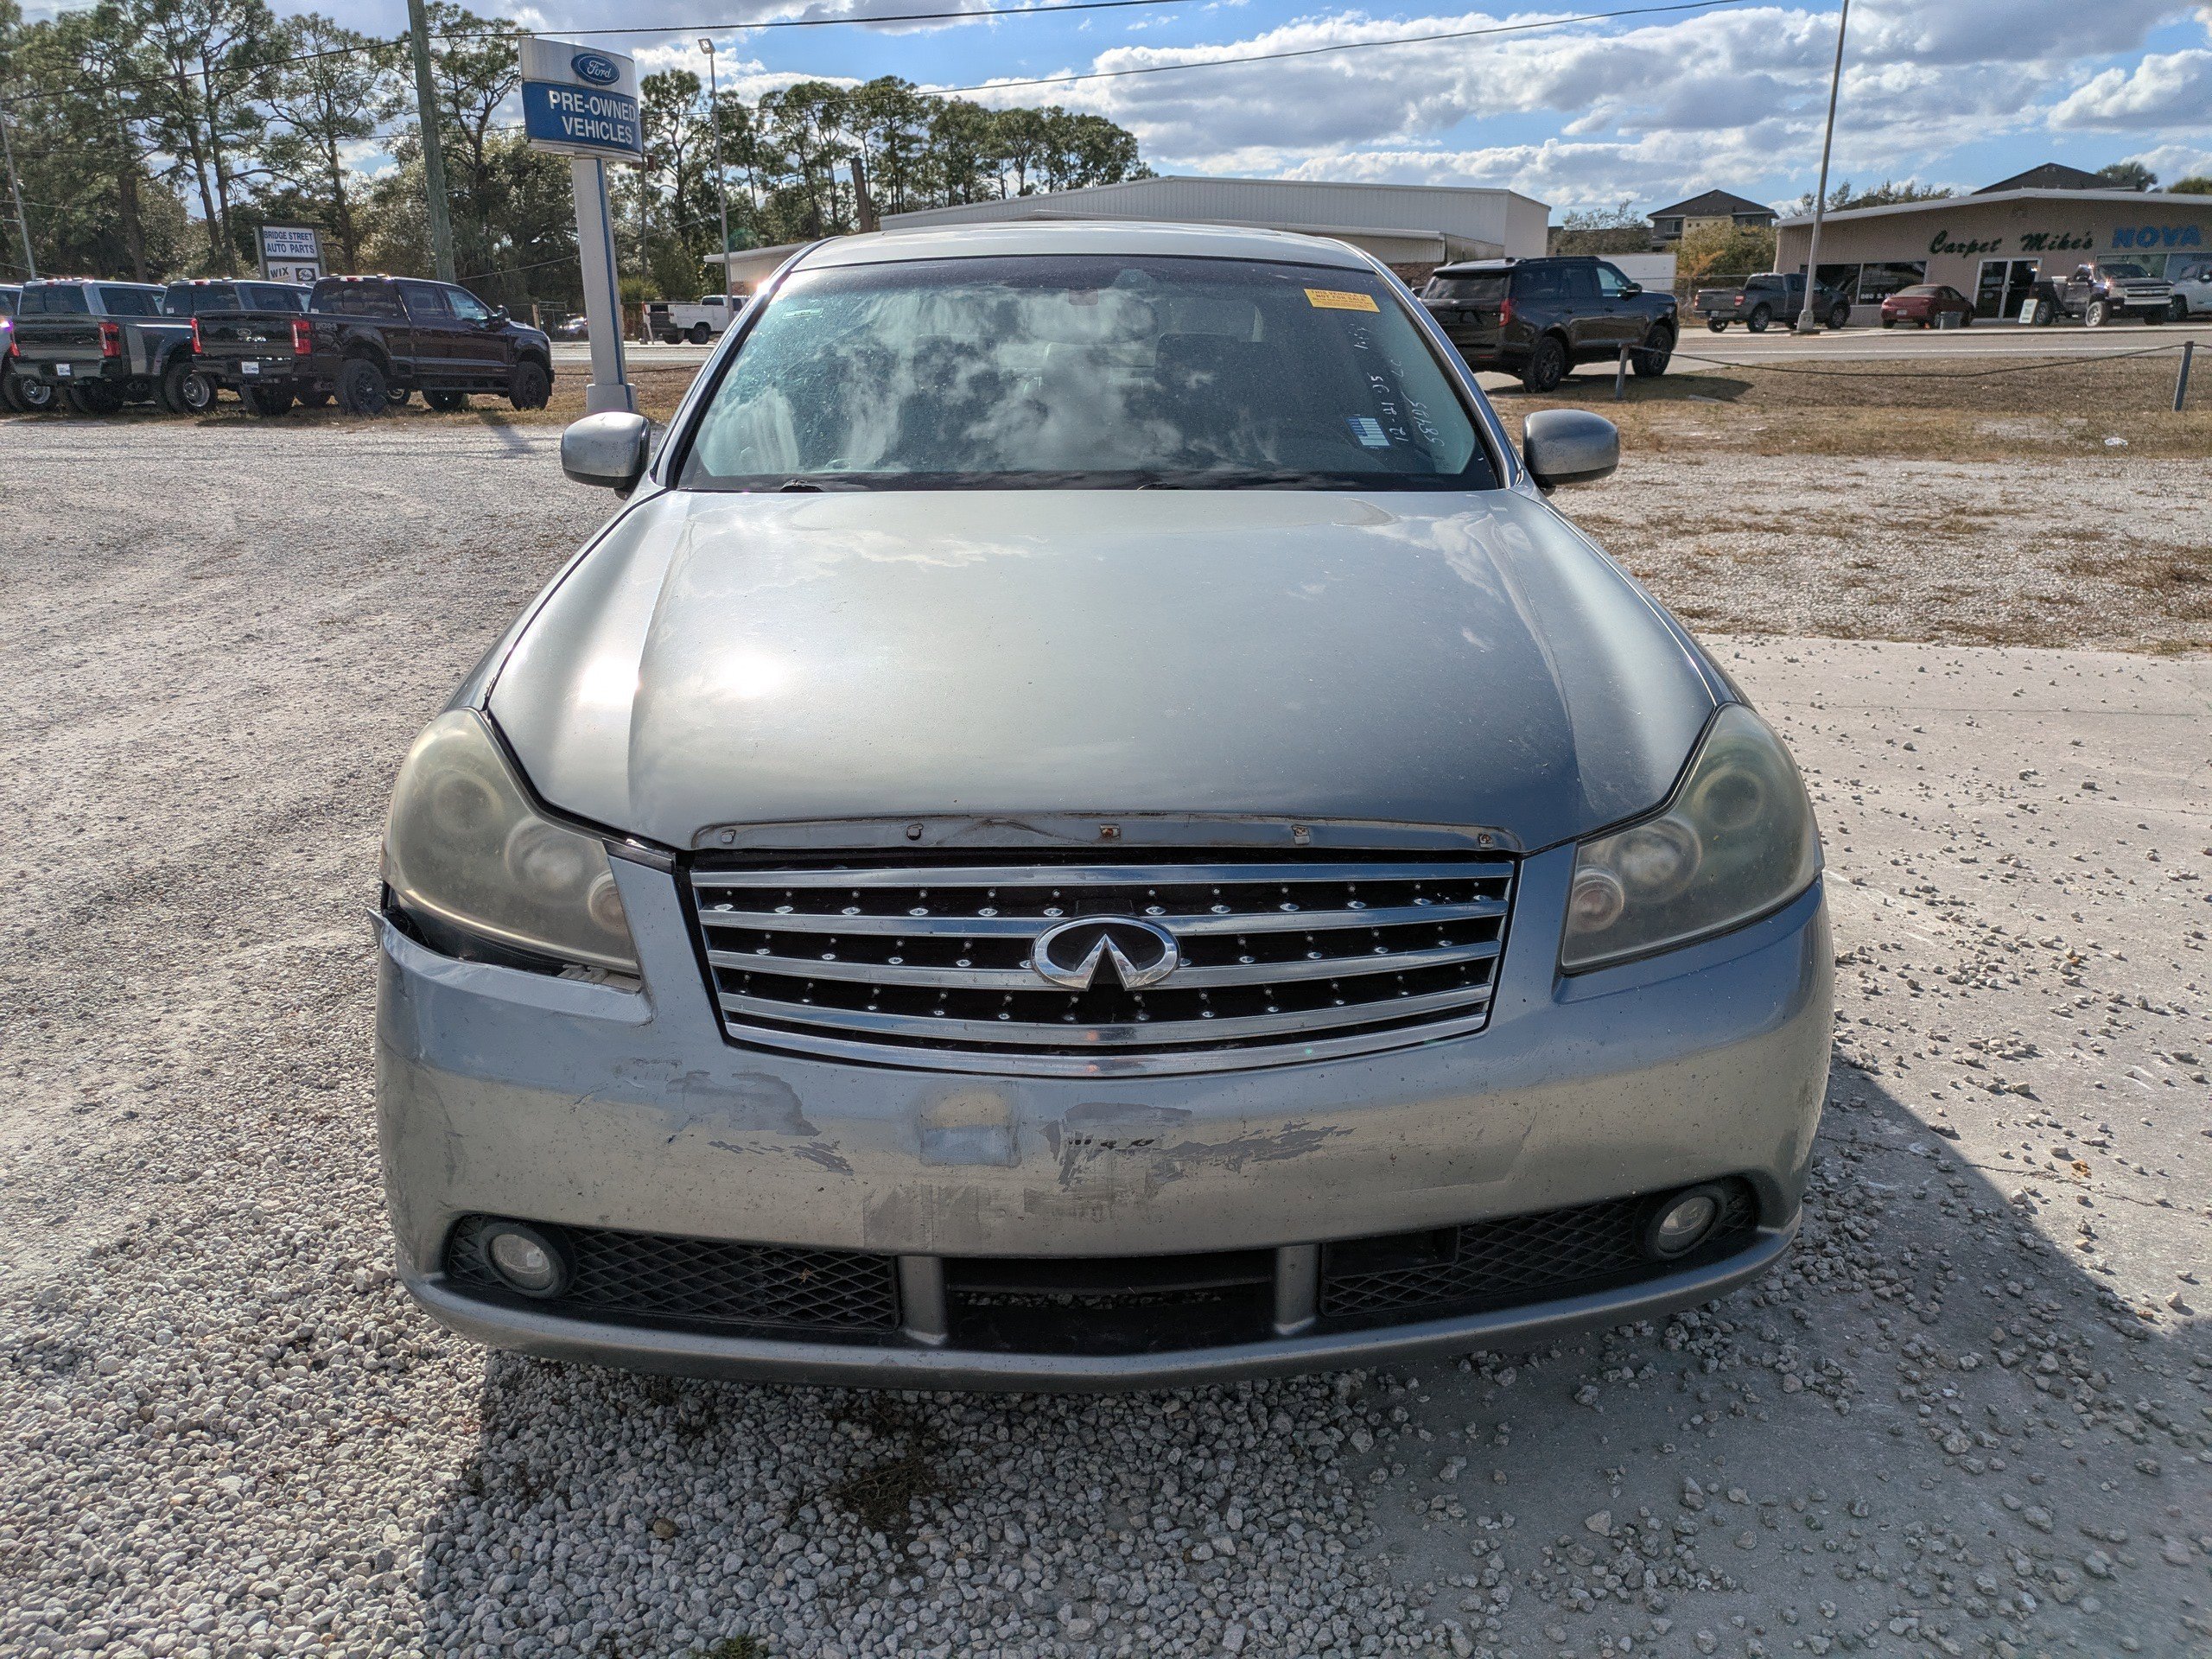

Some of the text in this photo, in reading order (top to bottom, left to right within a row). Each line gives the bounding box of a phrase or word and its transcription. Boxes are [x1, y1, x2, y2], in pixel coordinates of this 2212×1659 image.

[587, 60, 613, 79] Ford
[548, 90, 636, 123] PRE-OWNED
[562, 116, 633, 144] VEHICLES
[264, 231, 313, 241] BRIDGE STREET
[1929, 230, 2002, 258] Carpet
[2112, 225, 2202, 248] NOVA
[267, 243, 315, 254] AUTO PARTS
[270, 266, 289, 278] WIX
